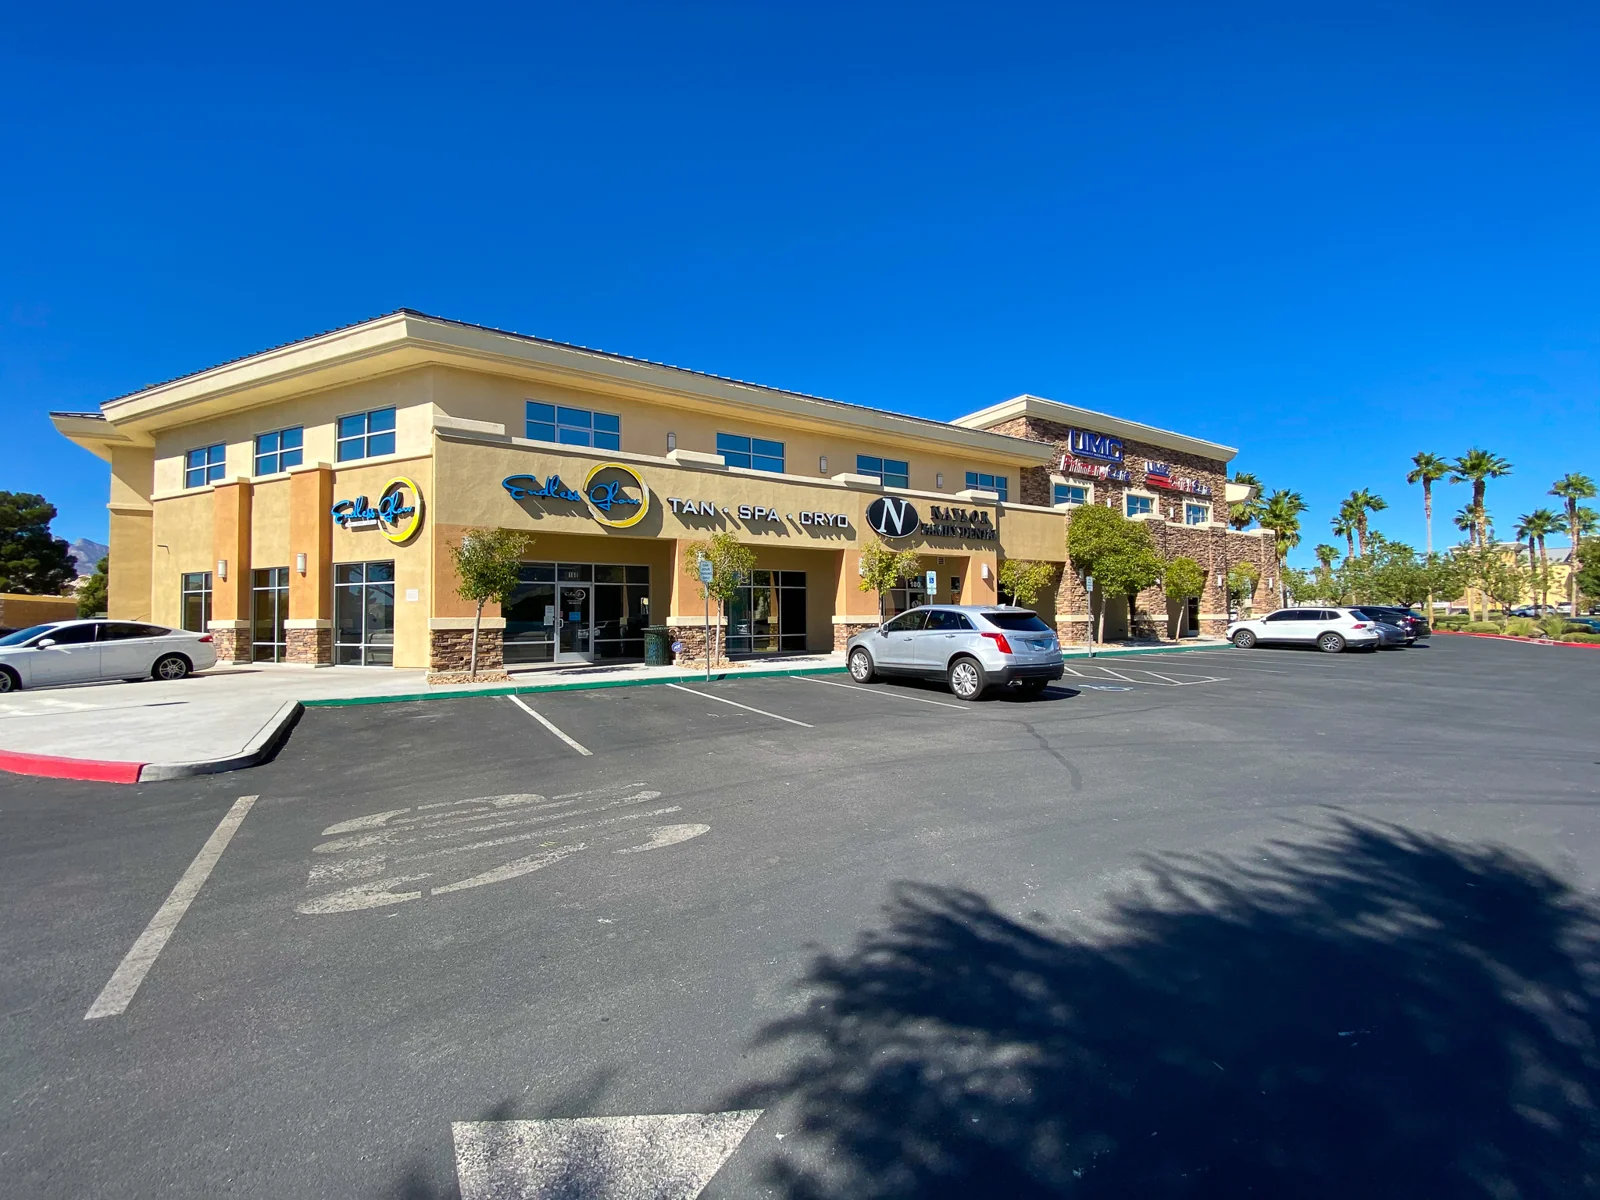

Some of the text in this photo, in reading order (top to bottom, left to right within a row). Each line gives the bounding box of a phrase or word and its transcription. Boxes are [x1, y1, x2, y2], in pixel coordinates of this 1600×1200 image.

[1068, 429, 1122, 462] UMC
[1060, 454, 1131, 482] Primary Care
[331, 491, 413, 525] Endless Glow
[502, 474, 640, 511] Endless Glow
[667, 497, 849, 528] TAN SPA CRYO
[877, 498, 909, 535] N
[930, 505, 989, 525] NAYLOR
[920, 523, 997, 541] FAMILY DENTAL
[293, 781, 711, 915] STOP
